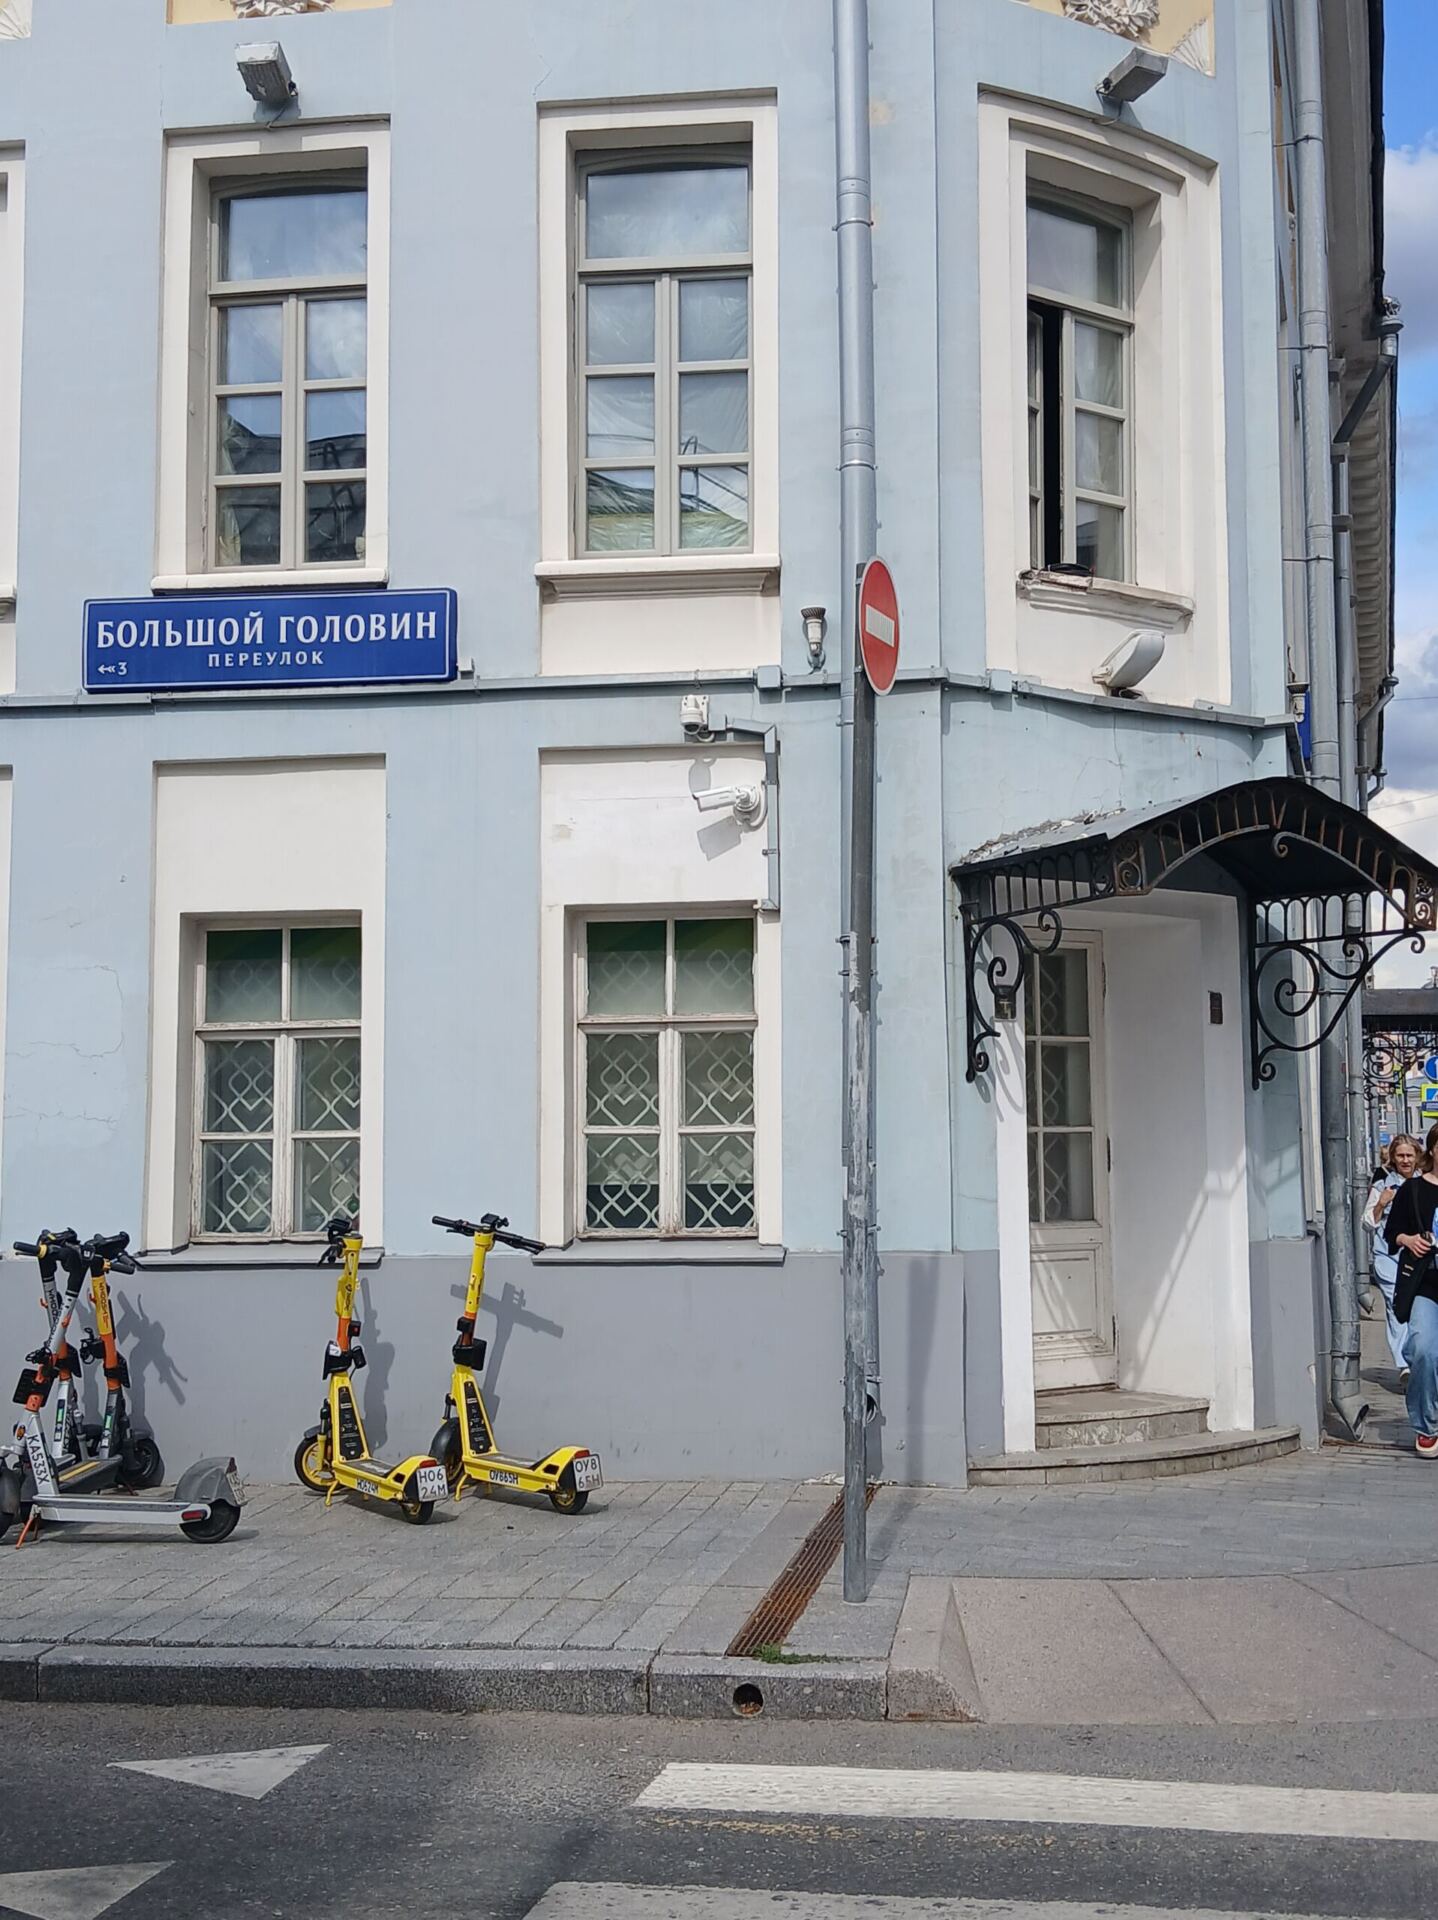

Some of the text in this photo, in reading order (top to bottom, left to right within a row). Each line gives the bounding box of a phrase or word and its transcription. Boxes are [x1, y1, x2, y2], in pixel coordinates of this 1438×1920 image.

[96, 610, 437, 648] БОЛЬШОЙ ГОЛОВИН
[207, 650, 325, 668] ПЕРЕУЛОК
[117, 662, 128, 676] 3
